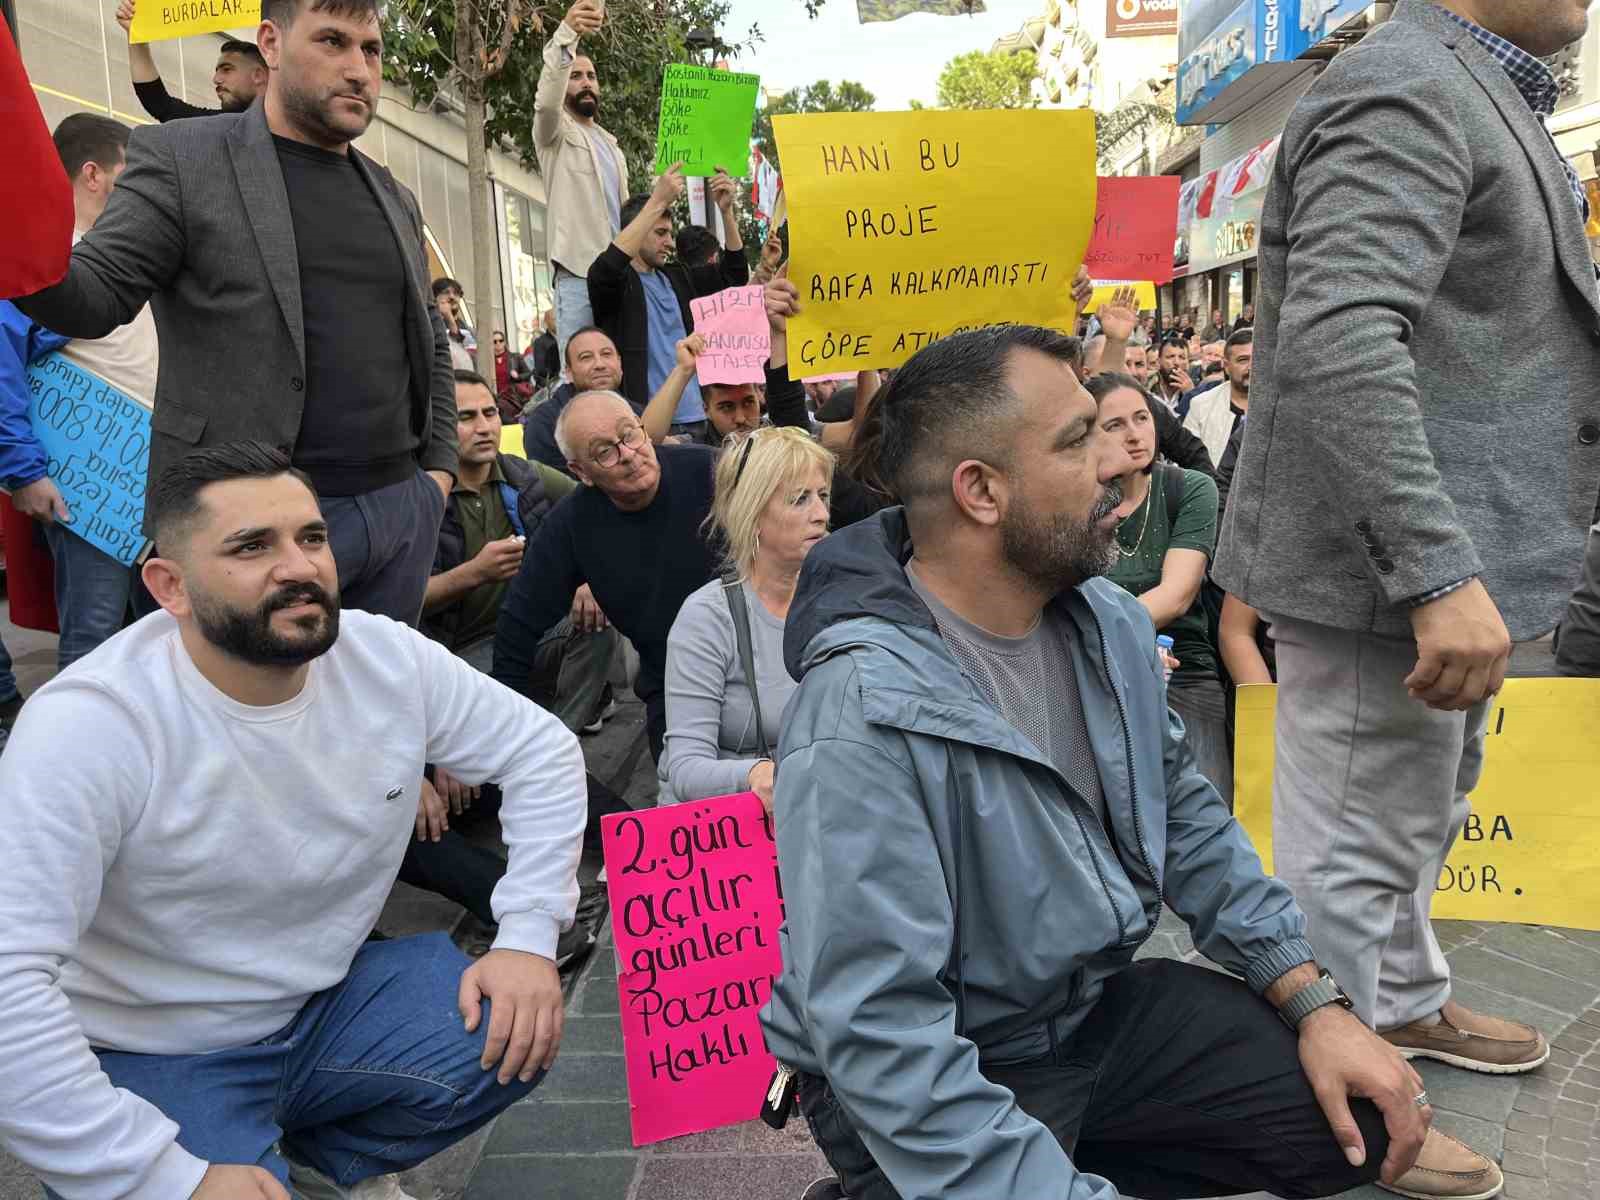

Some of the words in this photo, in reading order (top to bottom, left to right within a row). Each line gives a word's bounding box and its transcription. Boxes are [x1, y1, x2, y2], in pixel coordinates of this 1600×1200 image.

[662, 100, 691, 117] Söke
[662, 118, 688, 138] Söke
[821, 140, 891, 176] HANİ
[919, 138, 960, 171] BU
[846, 204, 938, 239] PROJE
[811, 272, 874, 302] RAFA
[891, 262, 1049, 296] KALKMAMIŞTI
[801, 331, 873, 367] ÇÖPE
[38, 387, 93, 441] 800
[95, 387, 144, 432] talep
[84, 515, 137, 561] Rant
[623, 867, 753, 938] açılır
[628, 912, 768, 993] günleri
[649, 1023, 748, 1082] Haklı
